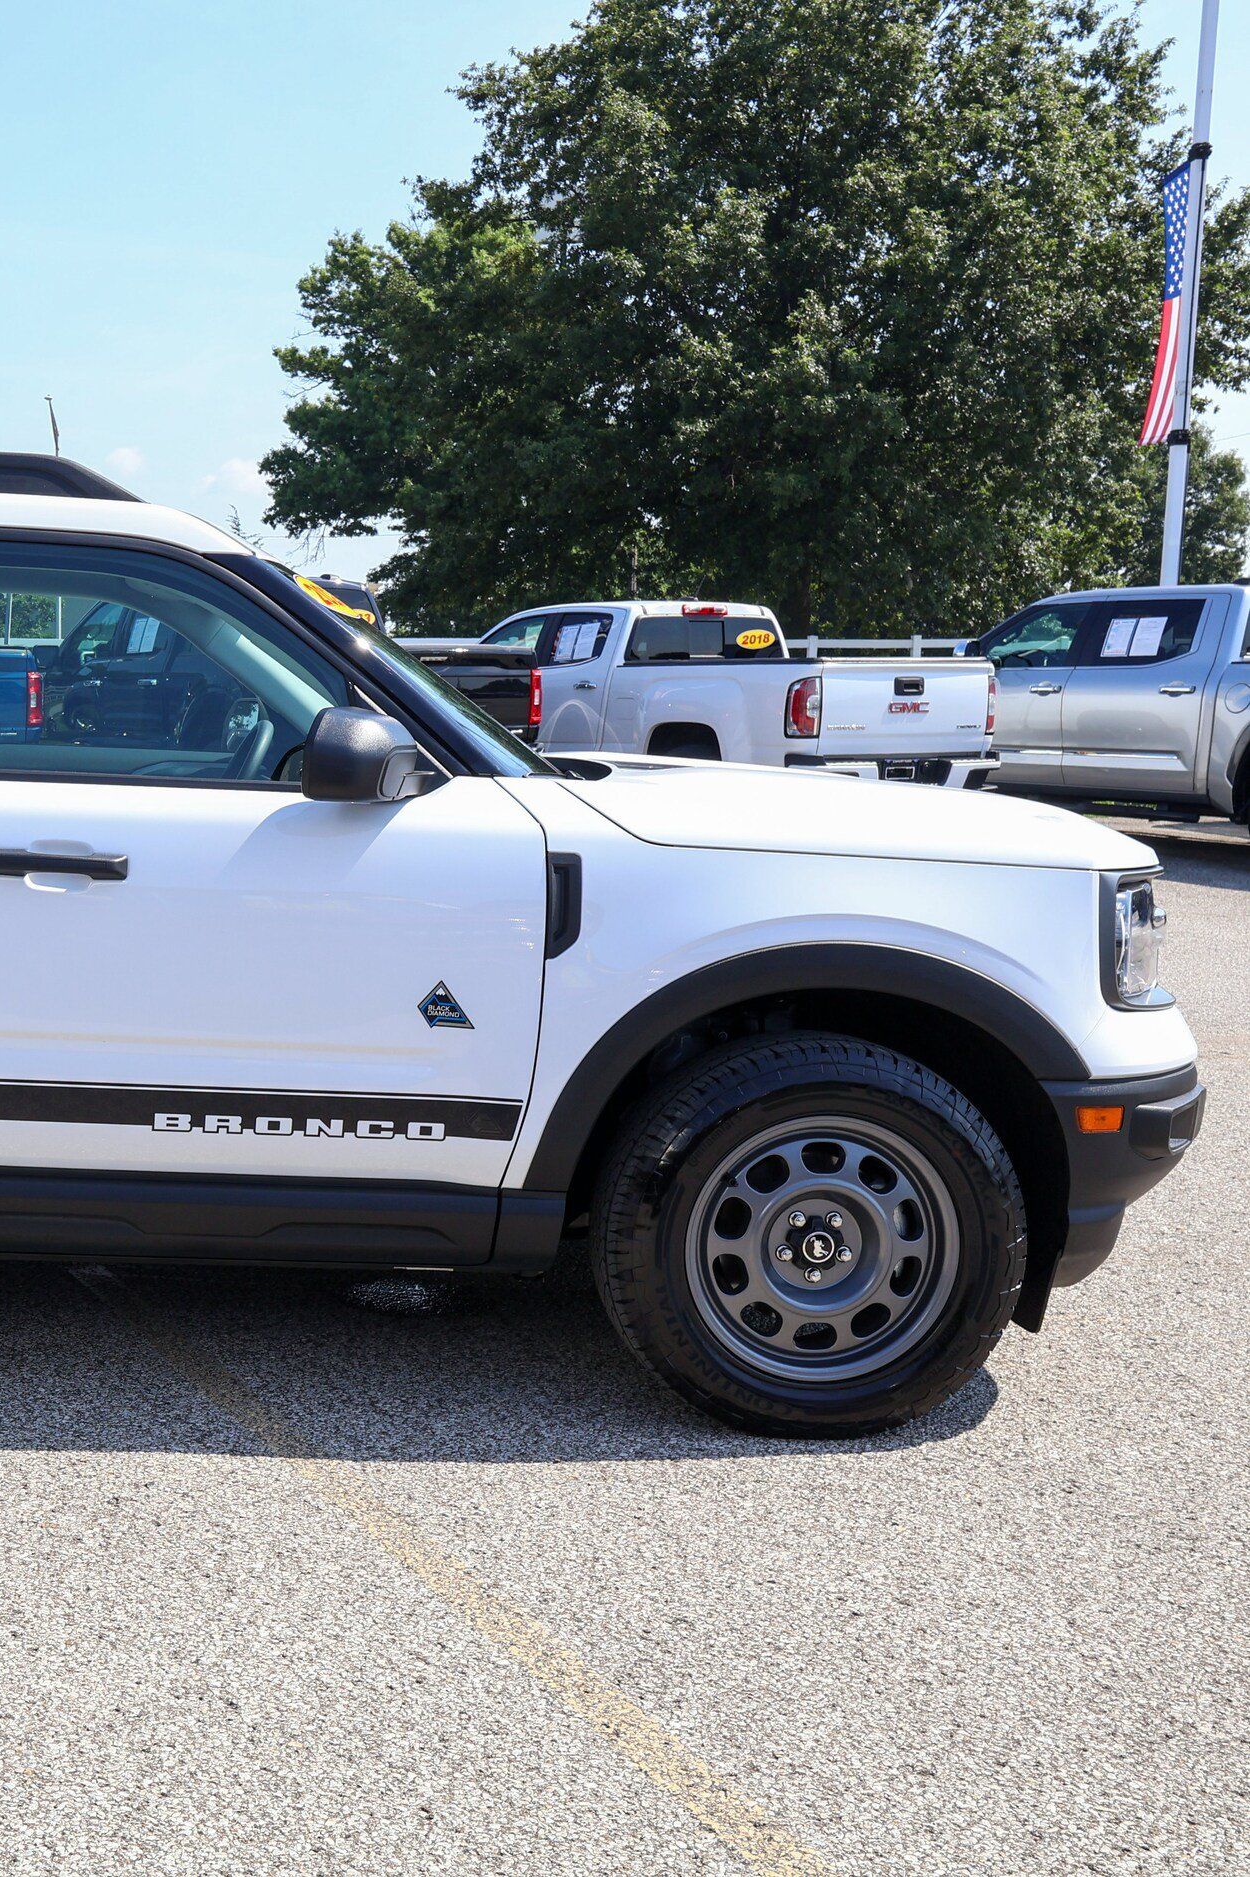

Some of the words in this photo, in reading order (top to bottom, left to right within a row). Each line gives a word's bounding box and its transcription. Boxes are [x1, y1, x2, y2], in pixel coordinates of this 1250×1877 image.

[741, 633, 771, 645] 2018
[888, 701, 930, 714] GMC
[153, 1113, 445, 1141] BRONCO
